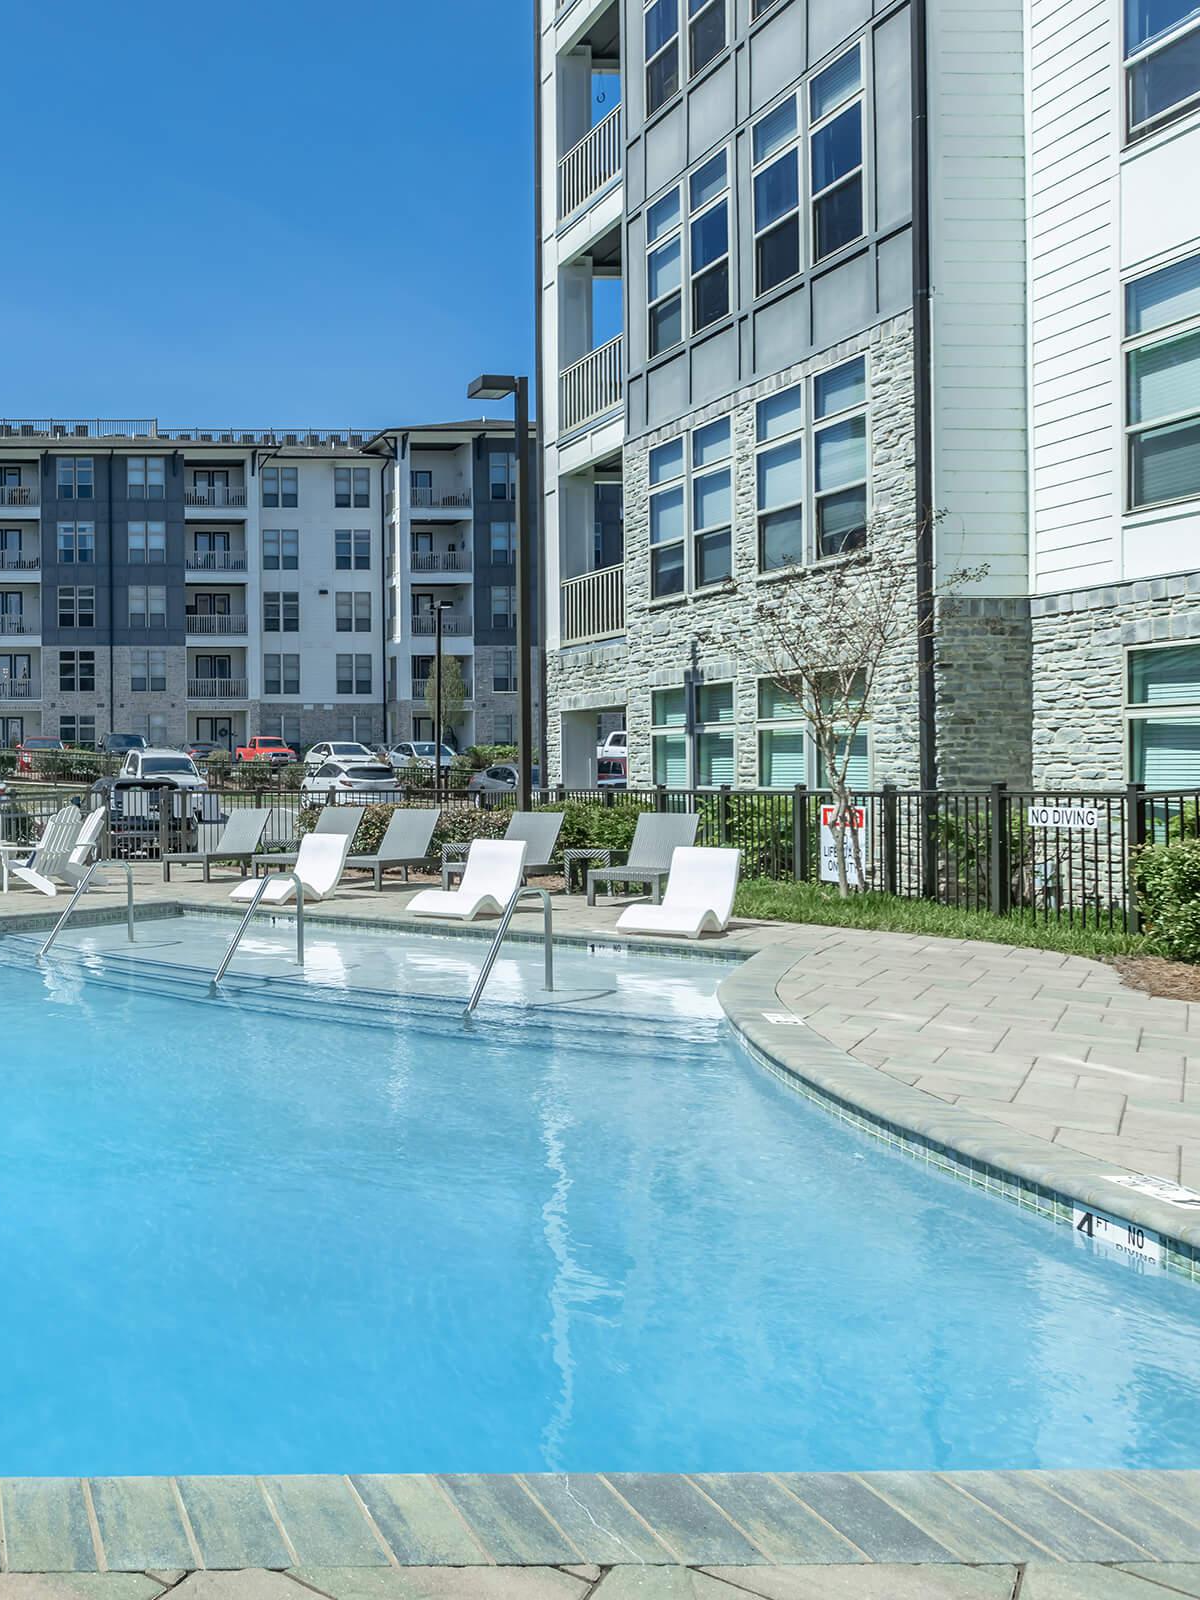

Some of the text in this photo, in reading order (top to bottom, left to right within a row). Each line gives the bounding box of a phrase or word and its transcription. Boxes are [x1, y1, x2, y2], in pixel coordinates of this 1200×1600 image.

[1031, 808, 1095, 826] NO DIVING
[1077, 1212, 1110, 1238] 4 FT
[1127, 1225, 1145, 1249] NO
